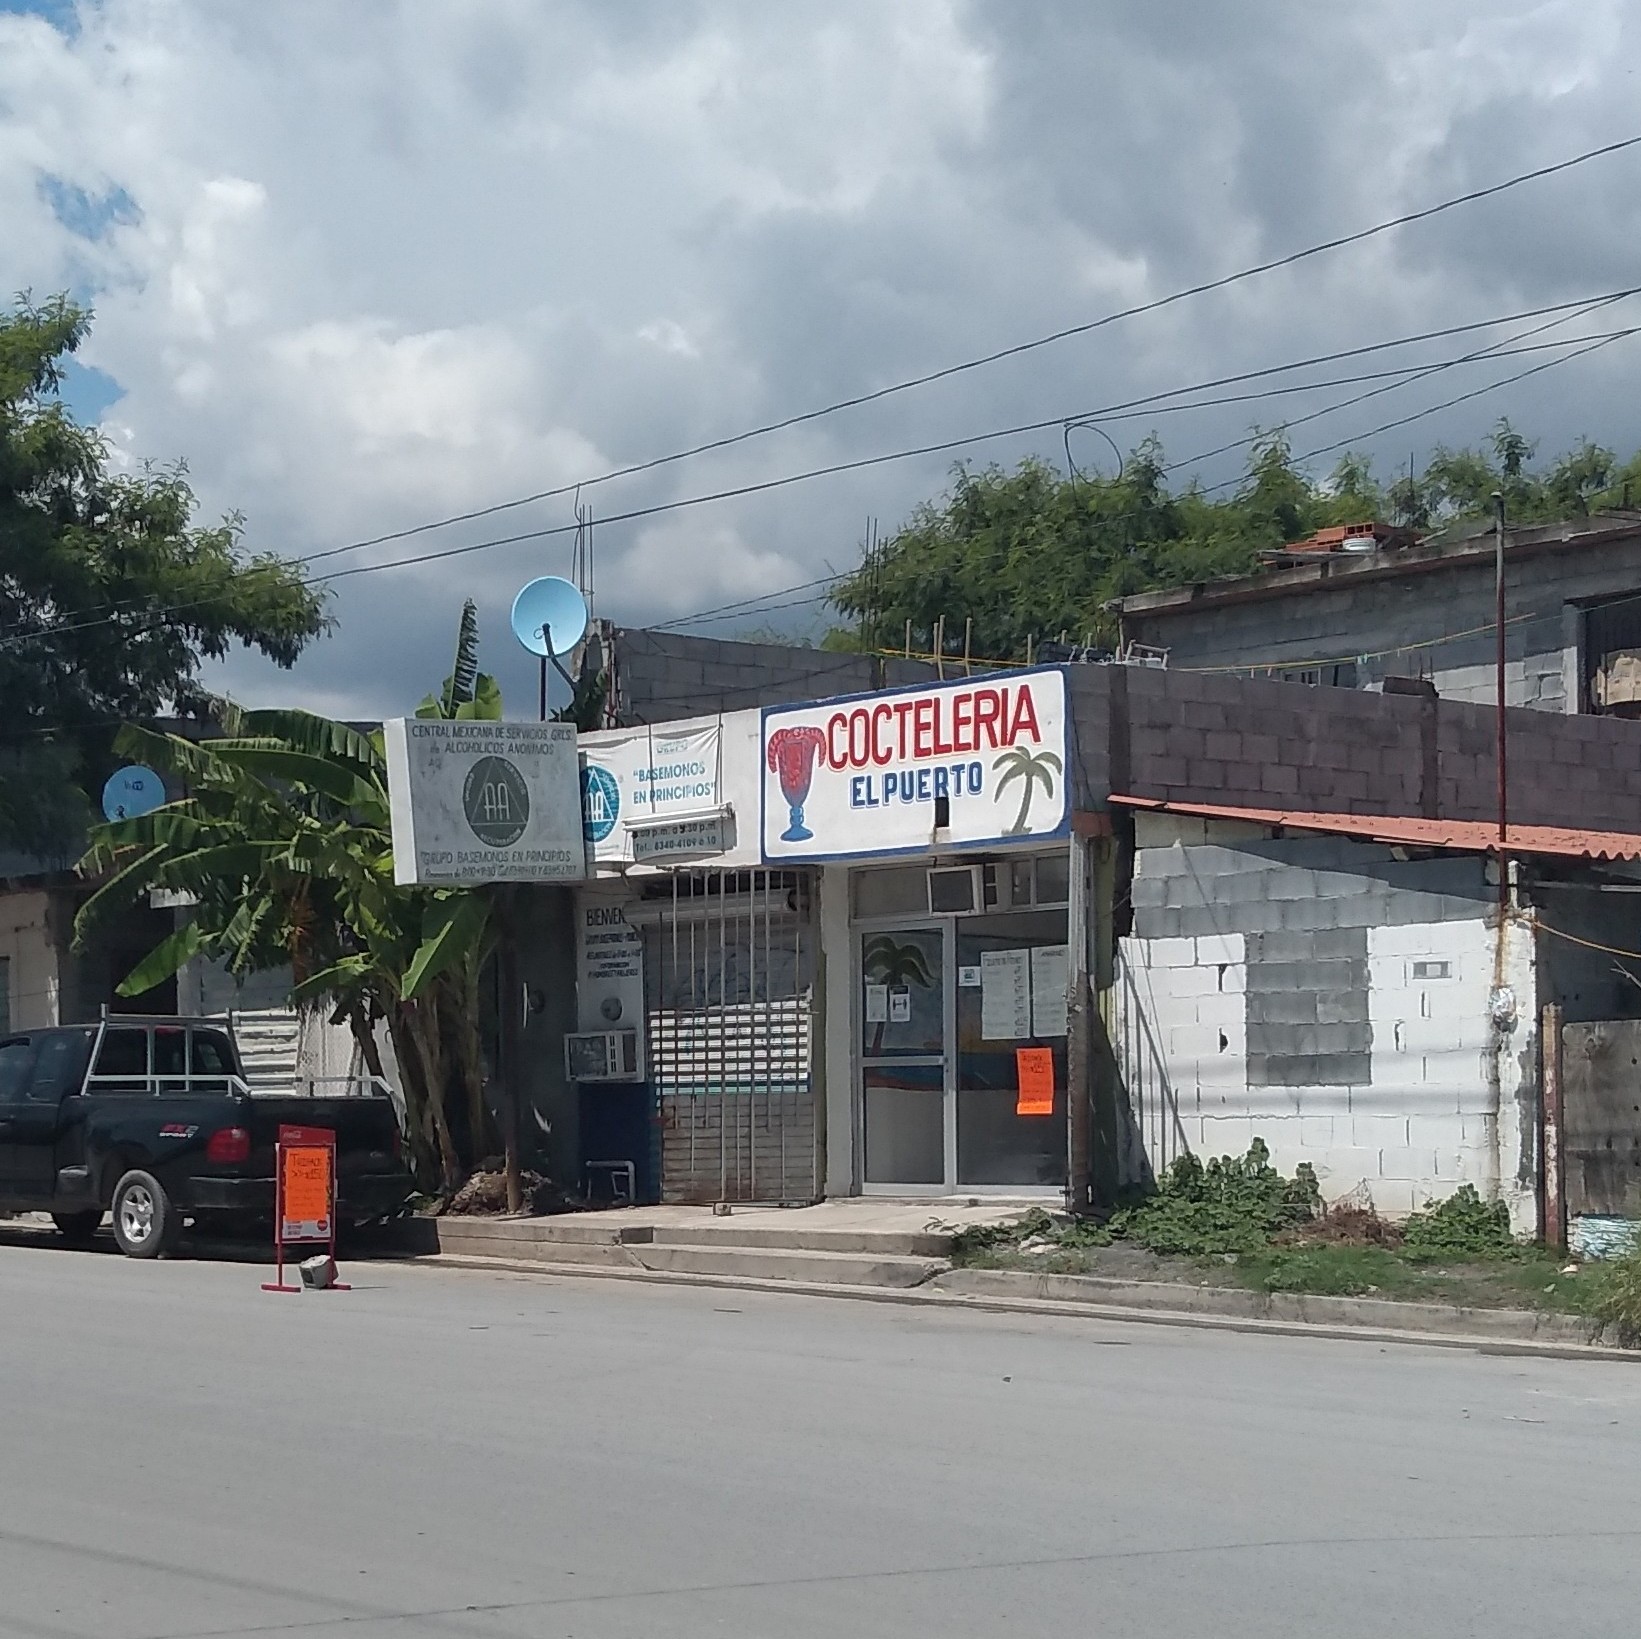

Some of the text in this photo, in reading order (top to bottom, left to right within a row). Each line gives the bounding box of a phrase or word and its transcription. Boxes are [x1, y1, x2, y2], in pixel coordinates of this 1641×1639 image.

[412, 725, 449, 738] CENTRAL
[452, 726, 493, 738] MEXICANA
[496, 727, 504, 738] DE
[506, 727, 547, 740] SERVICIOS
[828, 684, 1041, 769] COCTELERIA
[445, 742, 504, 755] ALCOHOLICOS
[508, 742, 554, 755] ANONIMOS
[852, 760, 984, 808] EL PUERTO
[484, 782, 510, 821] AA
[633, 790, 647, 804] EN
[457, 851, 508, 864] BASEMONOS
[512, 850, 523, 862] EN
[526, 850, 571, 863] PRINCIPIOS
